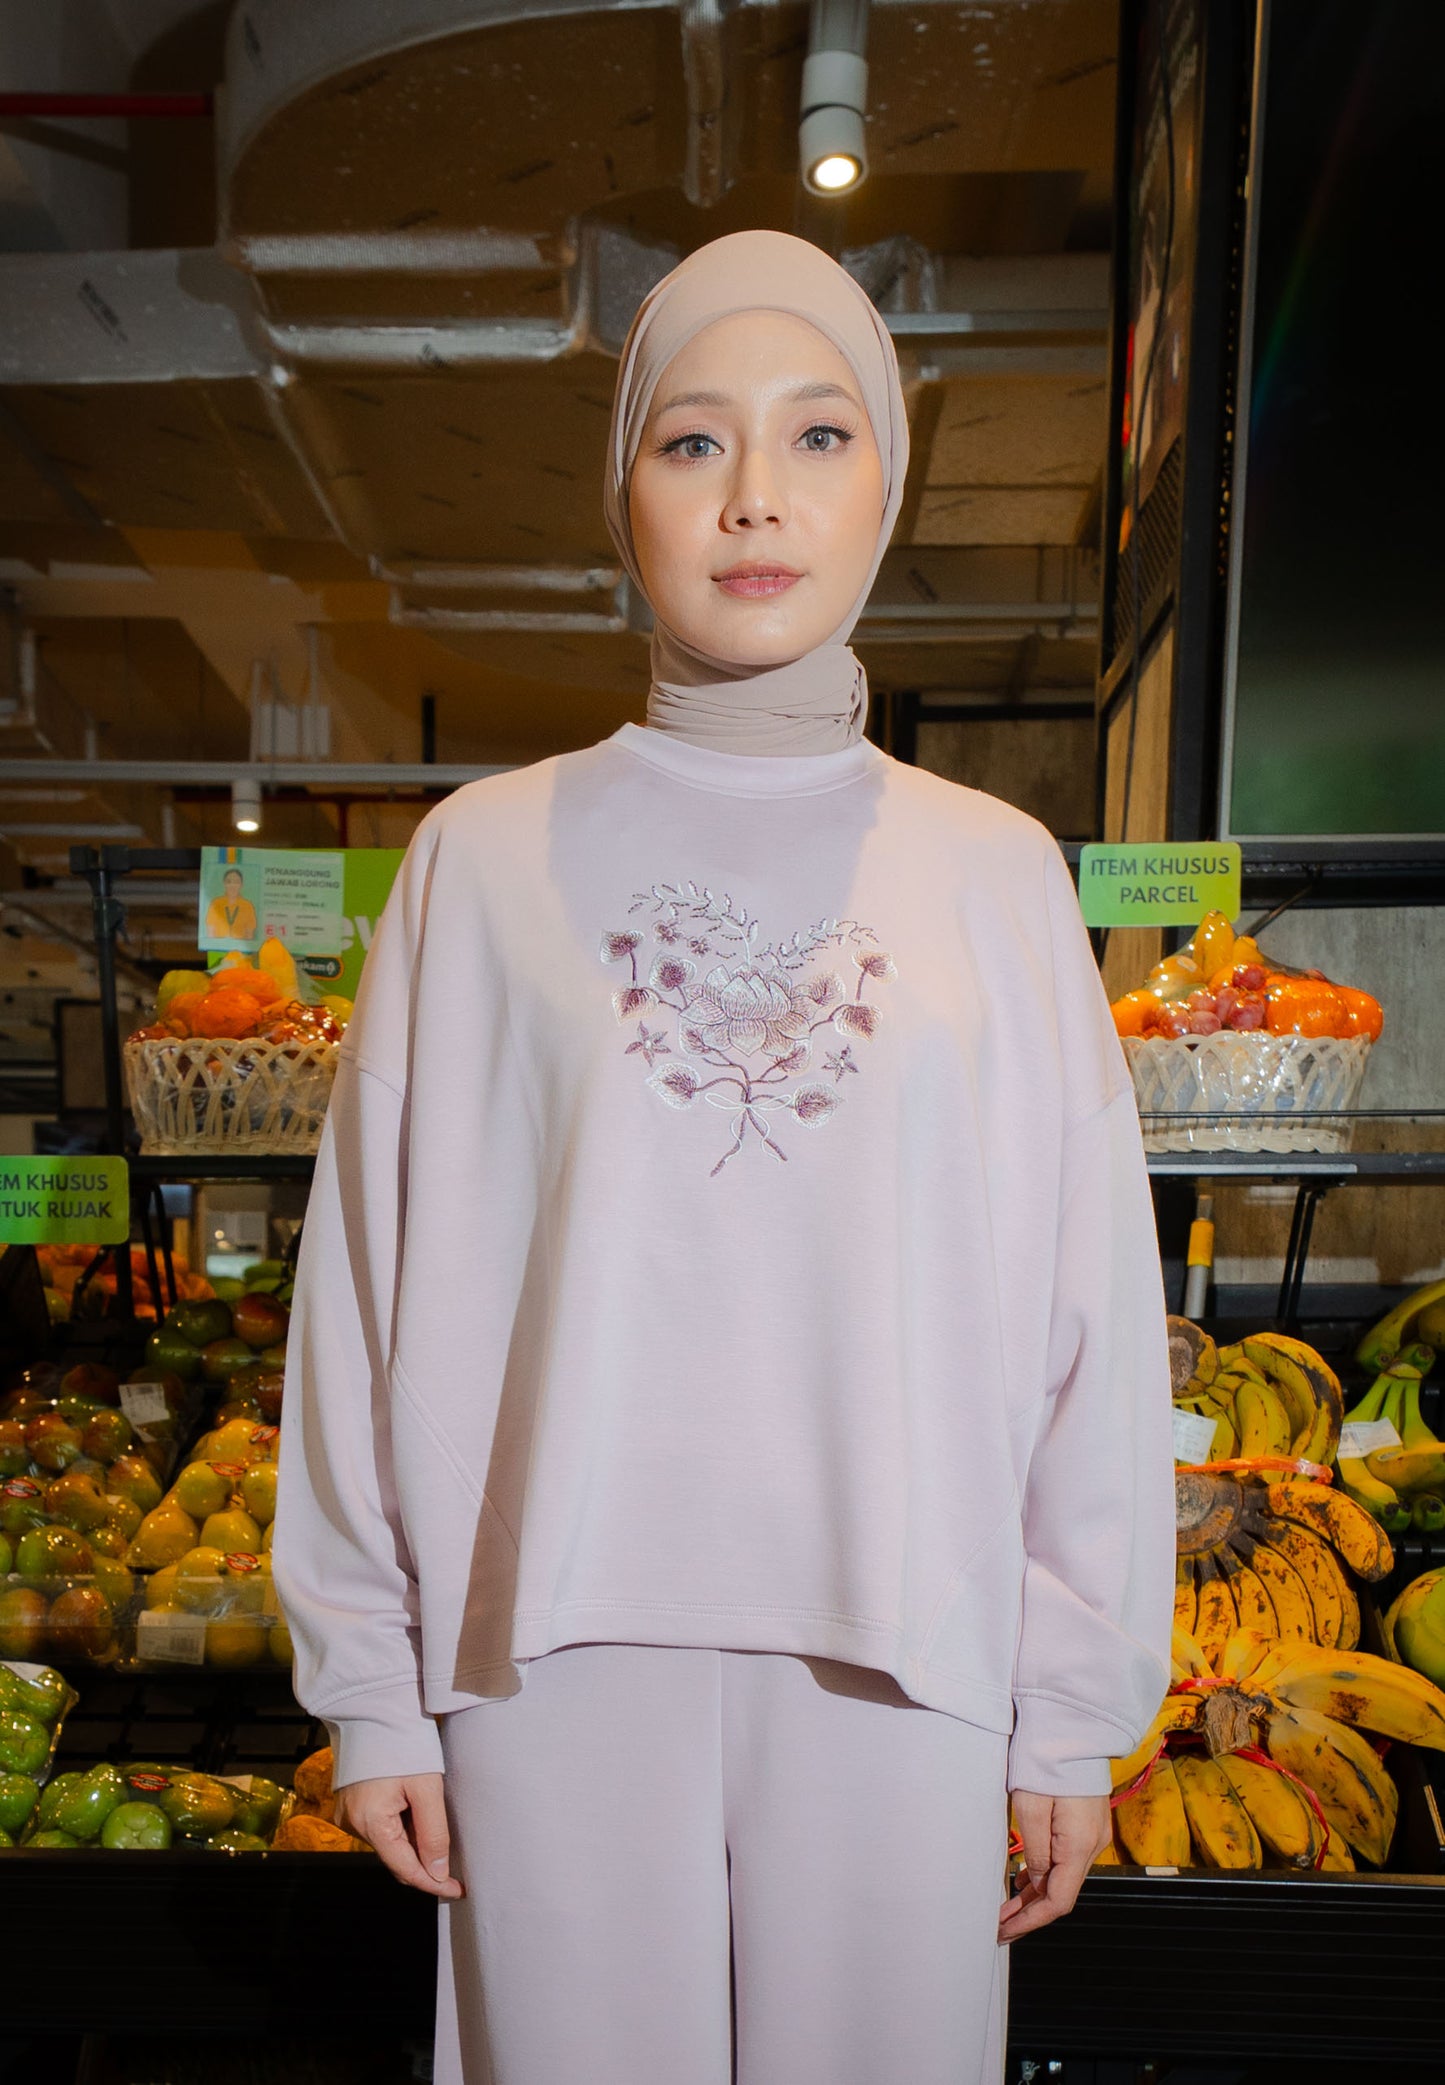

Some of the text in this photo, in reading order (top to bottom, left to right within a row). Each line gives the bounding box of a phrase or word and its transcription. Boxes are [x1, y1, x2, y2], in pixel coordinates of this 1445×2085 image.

[1091, 857, 1230, 876] ITEM KHUSUS
[1120, 886, 1199, 904] PARCEL
[0, 1174, 109, 1191] M KHUSUS
[0, 1201, 113, 1218] TUK RUJAK
